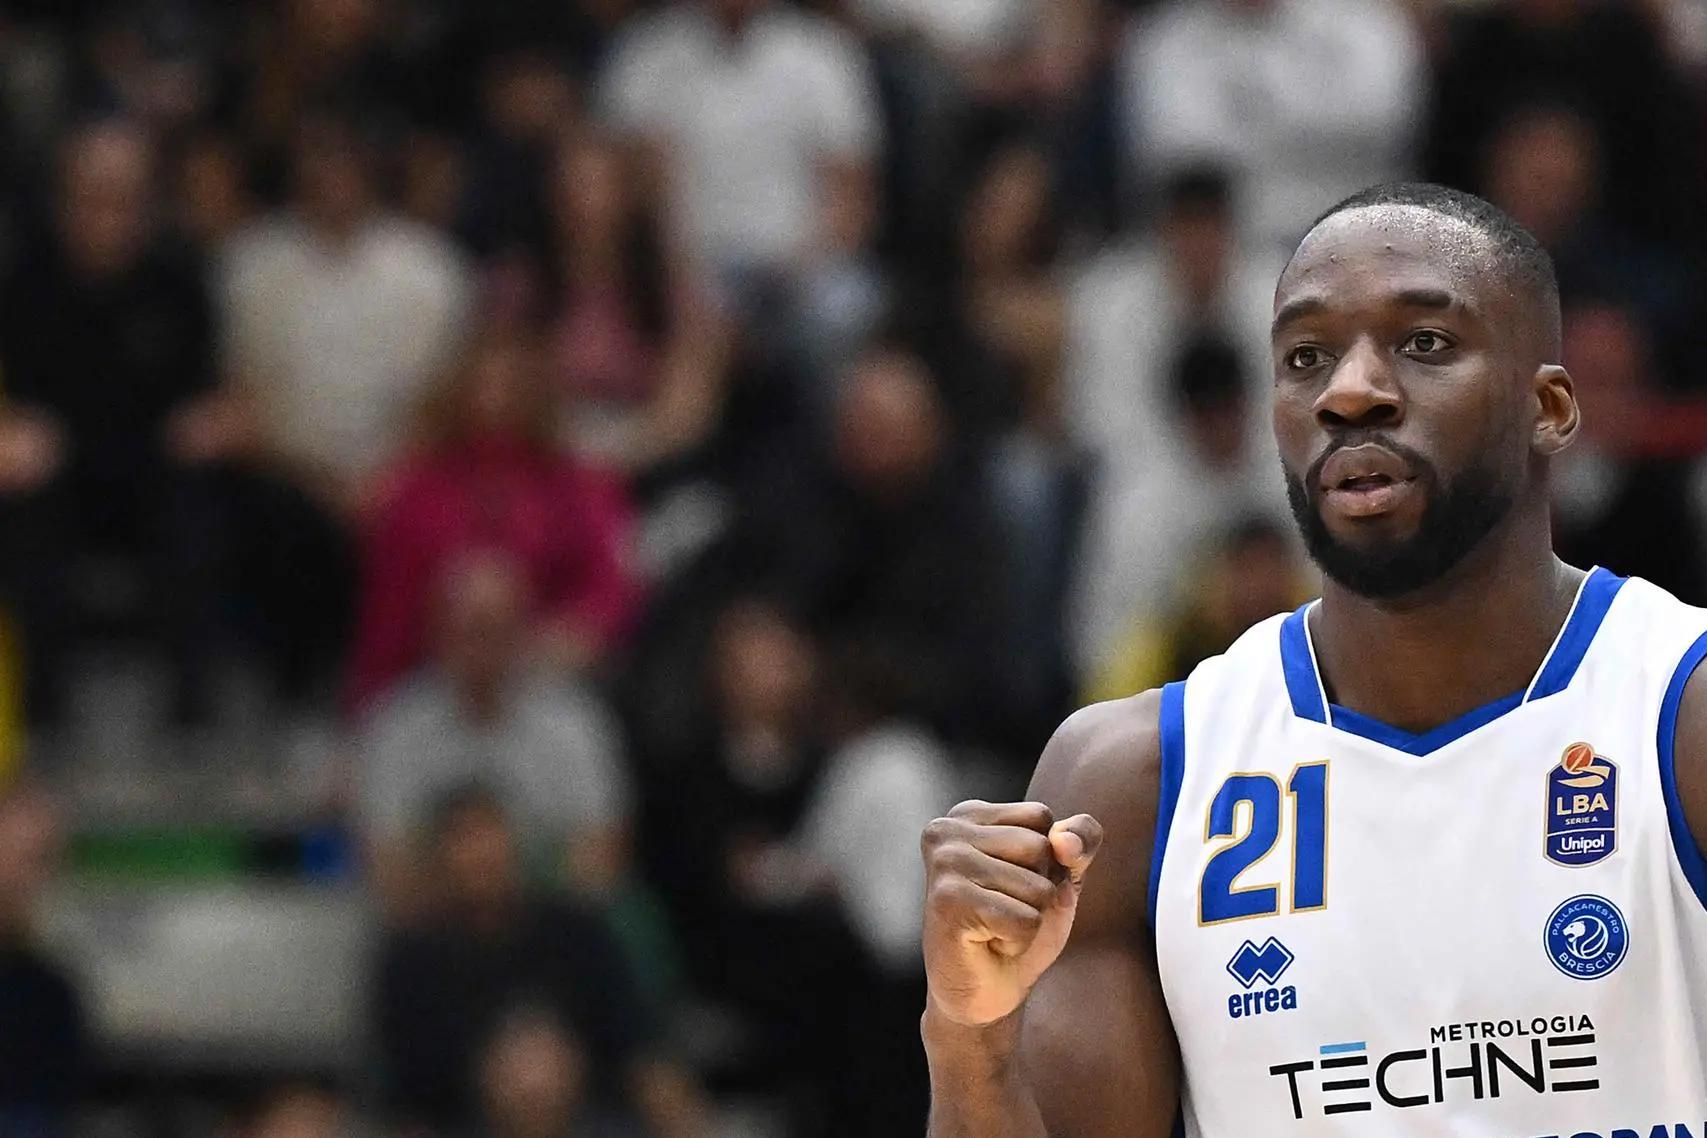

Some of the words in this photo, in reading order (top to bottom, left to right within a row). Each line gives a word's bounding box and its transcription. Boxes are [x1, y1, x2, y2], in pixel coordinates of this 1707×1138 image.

[1556, 793, 1609, 815] LBA
[1564, 817, 1591, 826] SERIE
[1591, 816, 1598, 824] A
[1198, 760, 1330, 926] 21
[1561, 834, 1605, 854] Unipol
[1552, 903, 1620, 936] PALLACANESTRO
[1559, 951, 1616, 974] BRESCIA
[1228, 985, 1297, 1018] errea
[1431, 1014, 1595, 1043] METROLOGIA
